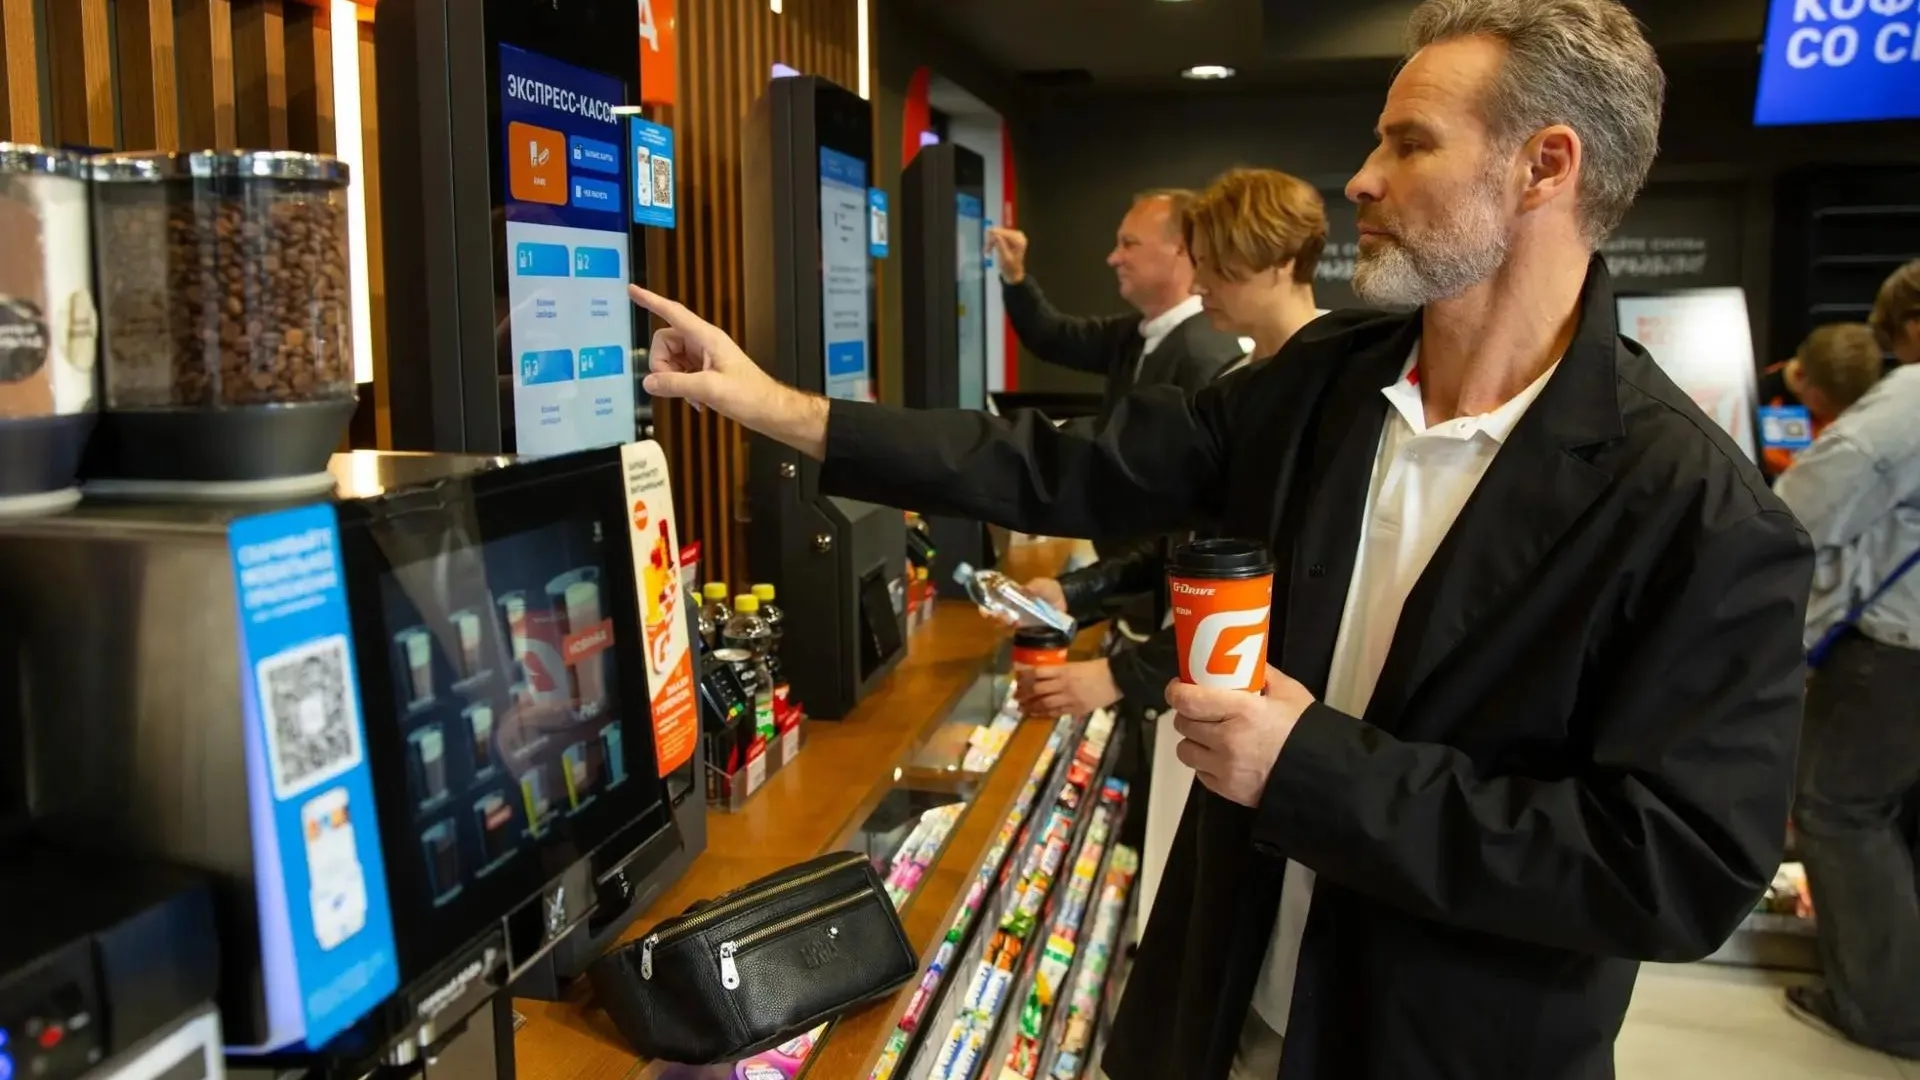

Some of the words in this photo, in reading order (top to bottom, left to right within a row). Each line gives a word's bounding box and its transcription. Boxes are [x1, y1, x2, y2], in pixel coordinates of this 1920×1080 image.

[1793, 0, 1920, 22] КОФ
[1786, 26, 1859, 69] СО
[507, 74, 617, 125] ЭКСПРЕСС-КАССА
[583, 254, 590, 269] 2
[532, 360, 539, 377] 3
